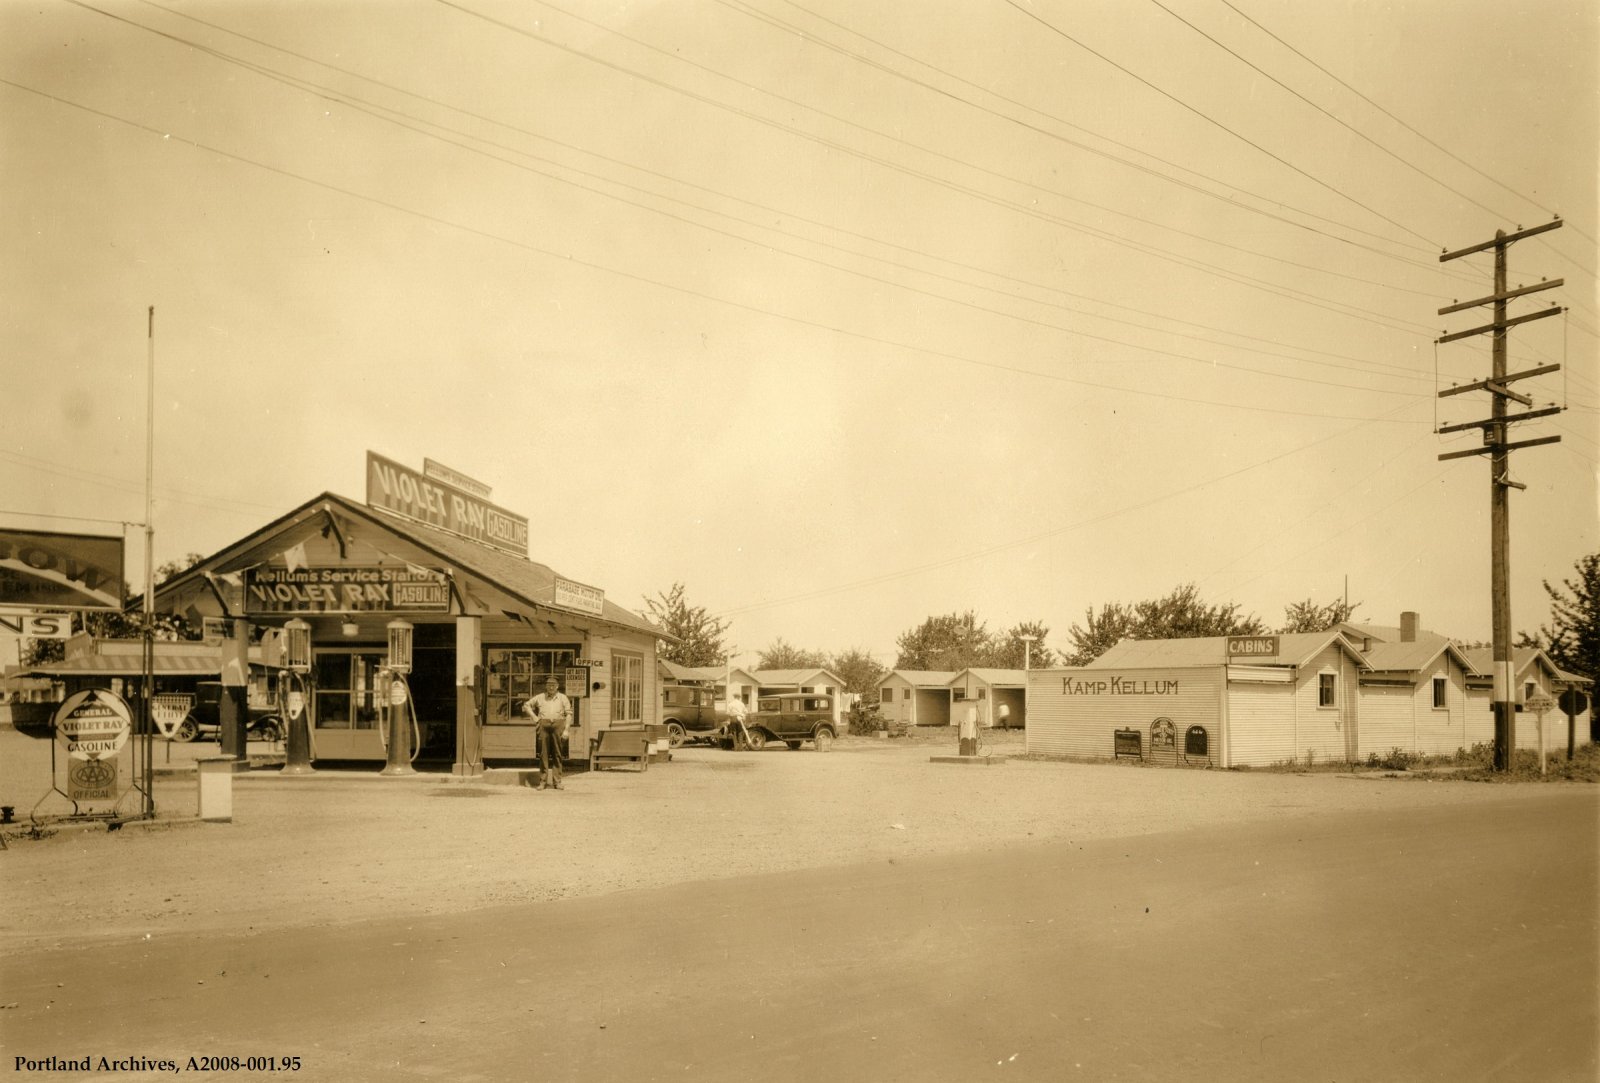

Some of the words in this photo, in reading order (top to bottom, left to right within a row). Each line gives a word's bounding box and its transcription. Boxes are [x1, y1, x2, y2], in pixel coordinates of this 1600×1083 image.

[372, 460, 447, 517] VIOLET
[452, 494, 485, 529] RAY
[487, 508, 528, 546] GASOLINE
[322, 570, 379, 583] Service
[250, 583, 337, 601] VIOLET
[343, 583, 391, 601] RAY
[392, 582, 448, 606] GASOLINE
[1229, 639, 1273, 653] CABINS
[577, 659, 604, 667] OFFICE
[1062, 676, 1107, 695] KAMP
[1110, 676, 1179, 695] KELLUM
[73, 708, 113, 717] GENERAL
[63, 721, 102, 731] VIOLET
[102, 720, 123, 730] RAY
[67, 741, 118, 752] GASOLINE
[79, 766, 109, 781] AAA
[73, 790, 109, 800] OFFICIAL
